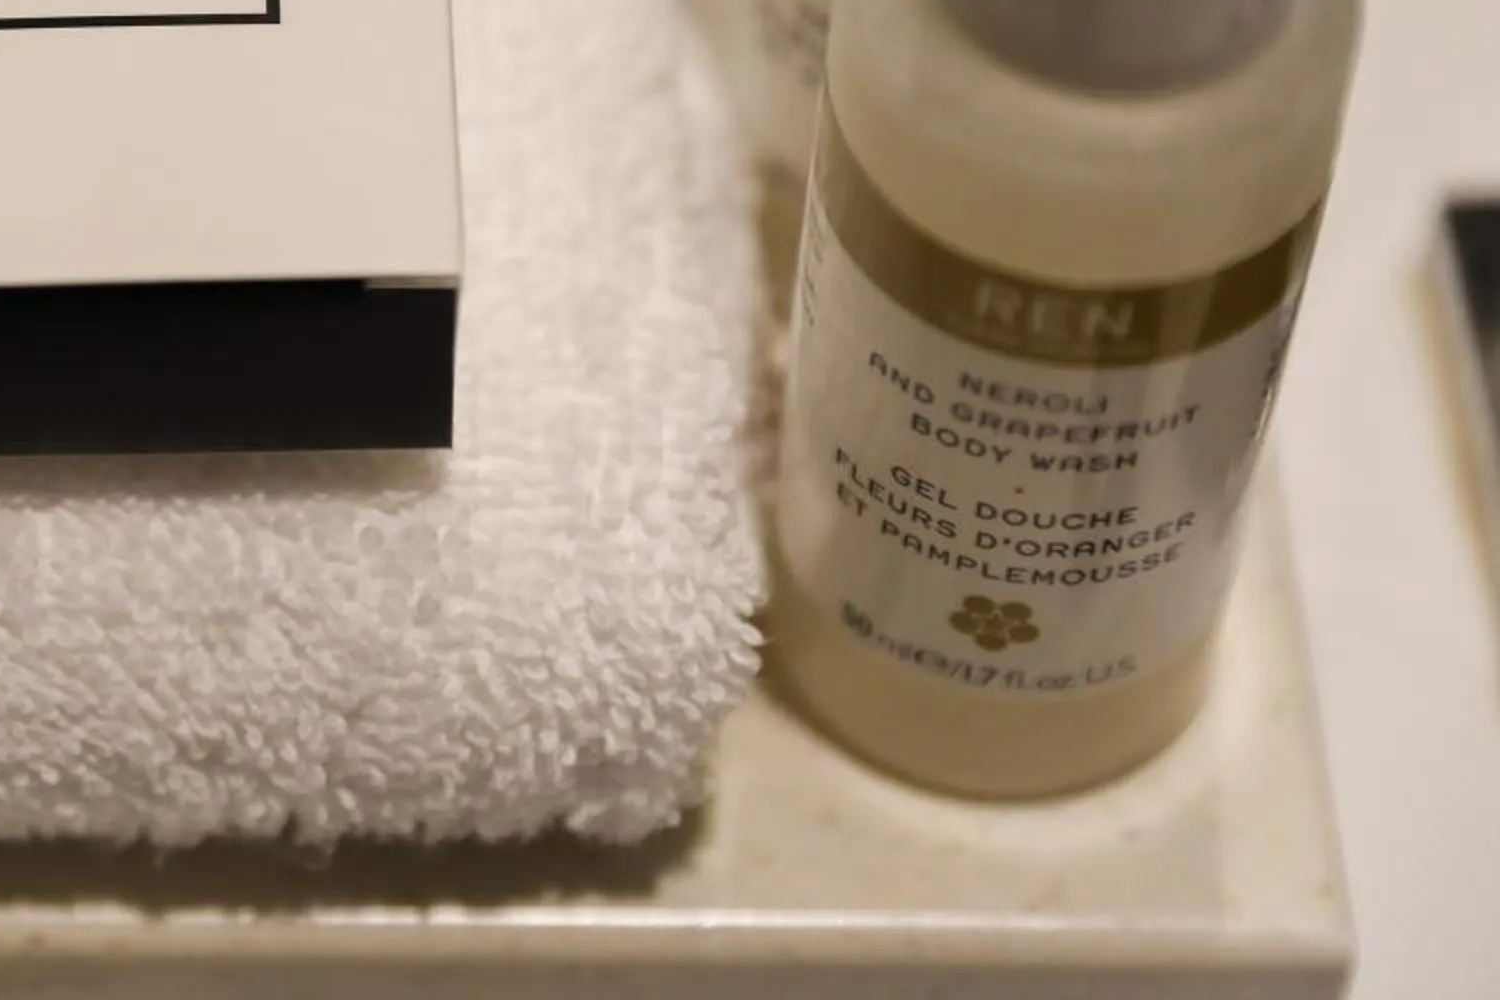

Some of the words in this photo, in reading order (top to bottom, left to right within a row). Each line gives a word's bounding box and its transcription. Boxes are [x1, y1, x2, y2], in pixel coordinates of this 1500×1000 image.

[974, 277, 1135, 340] REN
[867, 351, 935, 405] AND
[950, 402, 1202, 445] GRAPEFRUIT
[958, 372, 1109, 415] NEROLI
[910, 412, 1013, 464] BODY
[1029, 451, 1140, 473] WASH
[835, 447, 958, 539] FLEURS
[974, 509, 1196, 560] D'ORANGER
[889, 464, 958, 511] GEL
[974, 500, 1140, 531] DOUCHE
[836, 481, 869, 517] ET
[880, 519, 1186, 587] PAMPLEMOUSSE
